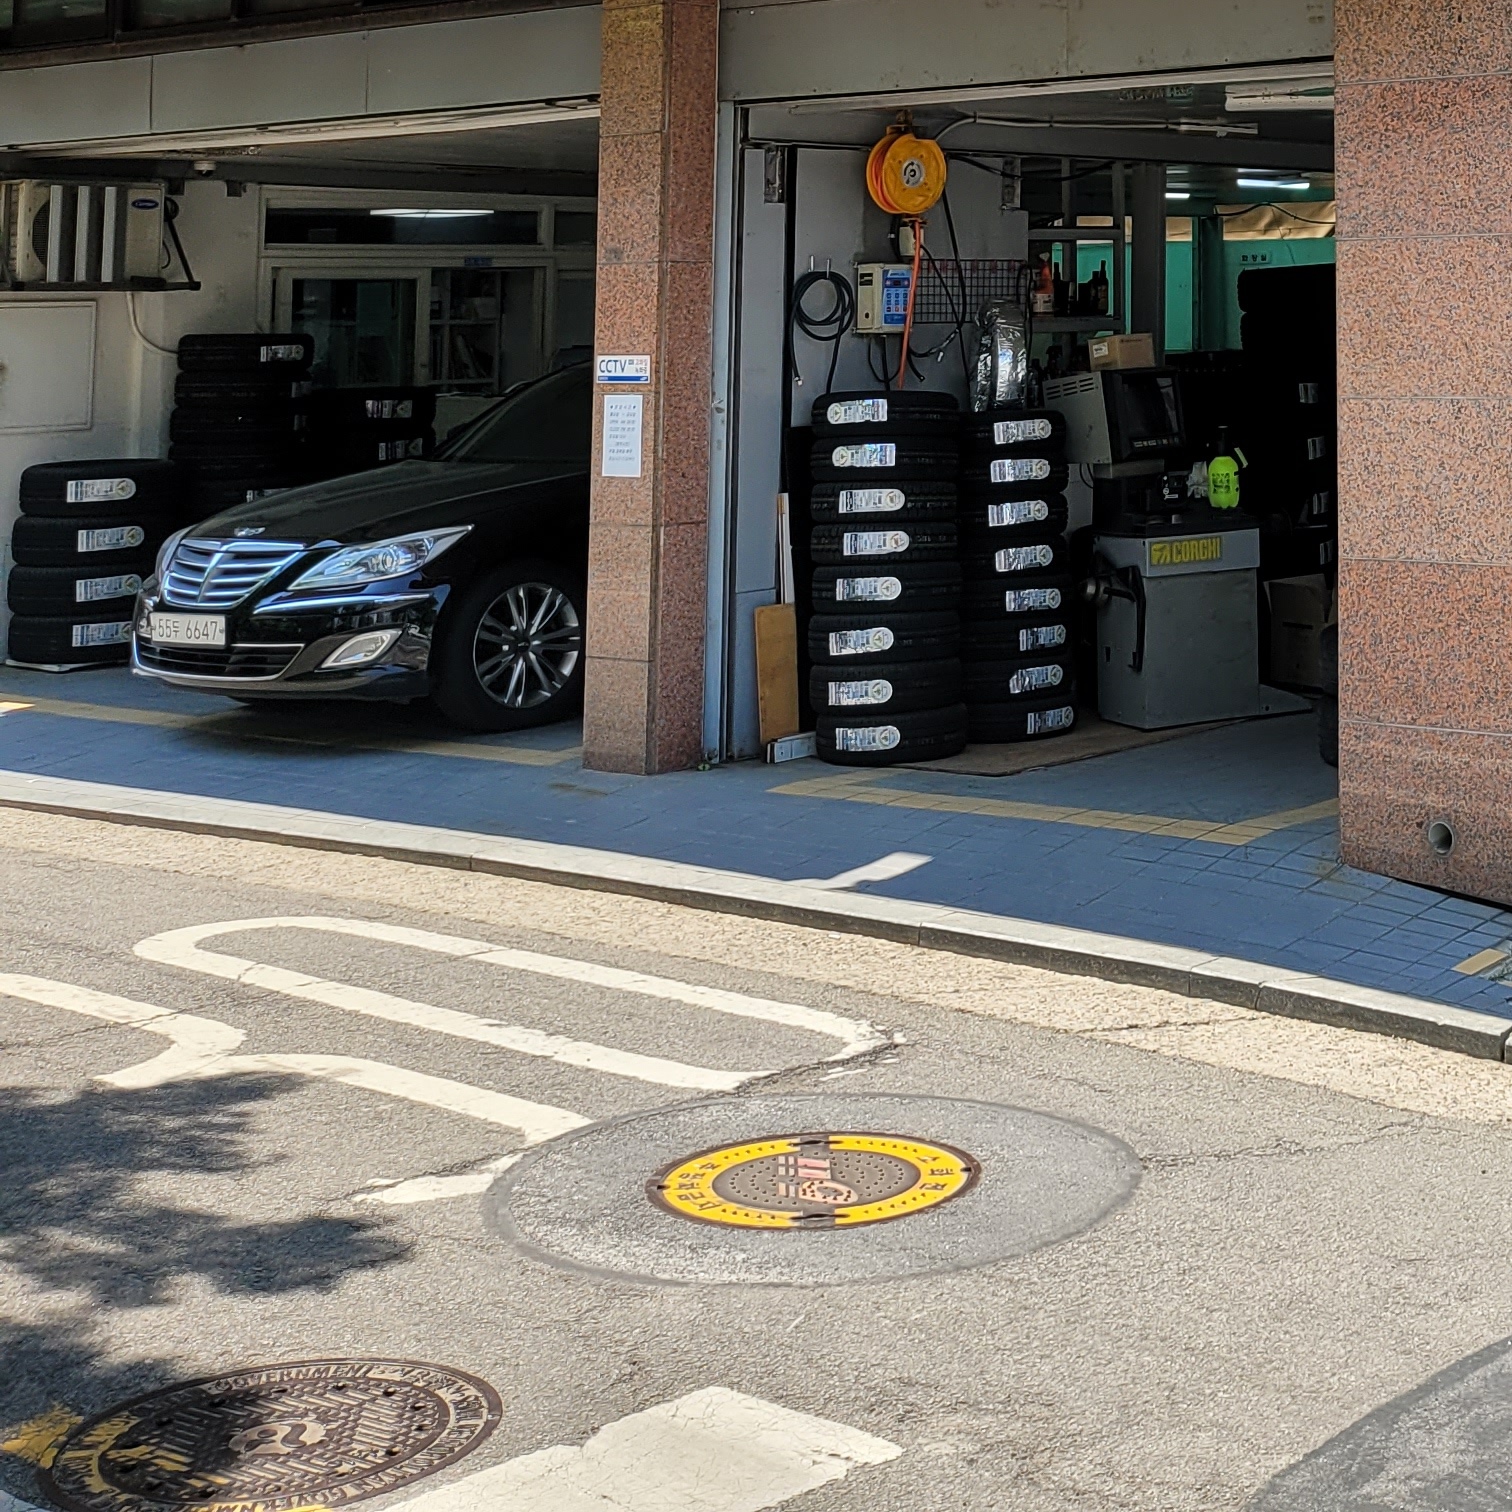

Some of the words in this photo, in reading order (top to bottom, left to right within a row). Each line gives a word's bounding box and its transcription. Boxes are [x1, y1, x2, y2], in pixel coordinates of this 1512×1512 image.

[599, 359, 627, 374] CCTV
[1172, 536, 1221, 563] CORGHI
[158, 618, 180, 638] 55두
[185, 619, 218, 641] 6647
[915, 1154, 956, 1193] 소화전
